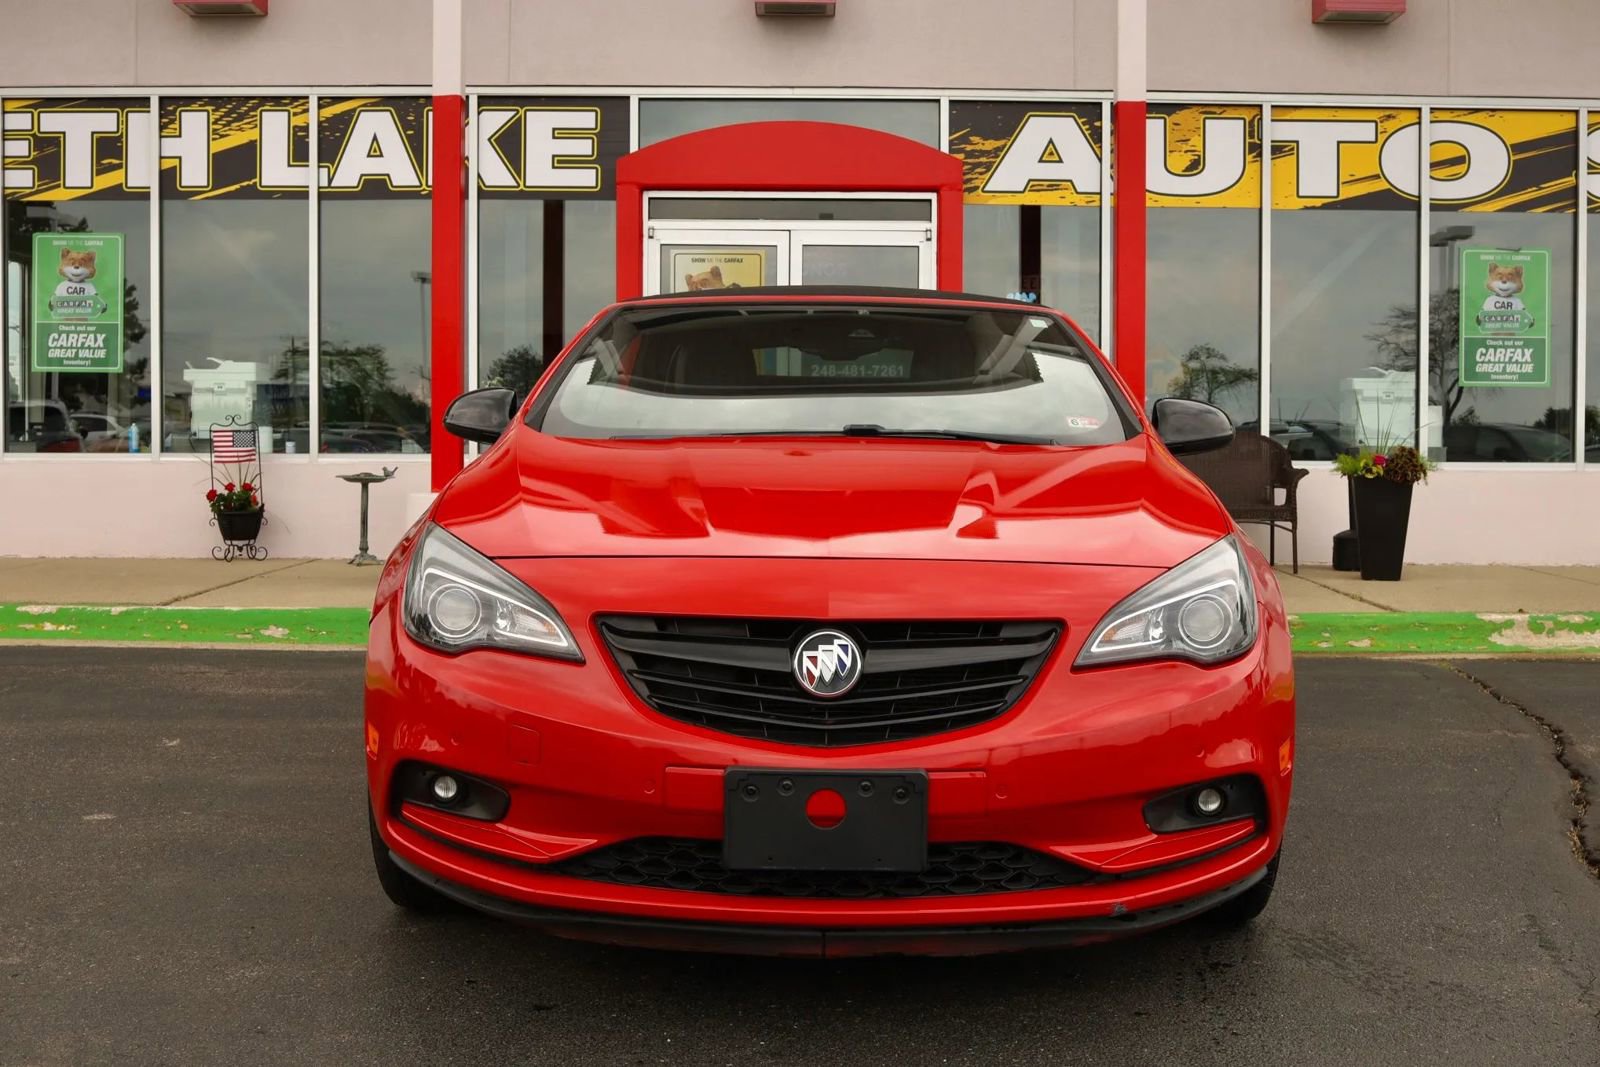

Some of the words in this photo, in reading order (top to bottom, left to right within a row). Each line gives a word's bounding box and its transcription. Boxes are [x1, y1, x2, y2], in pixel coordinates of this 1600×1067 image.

[260, 109, 598, 189] LAKE
[981, 115, 1510, 202] AUTO
[66, 286, 86, 295] CAR
[1494, 301, 1513, 310] CAR
[48, 333, 106, 347] CARFAX
[48, 349, 77, 358] GREAT
[78, 349, 107, 358] VALUE
[1475, 347, 1534, 362] CARFAX
[811, 365, 904, 377] 248-481-7261
[1475, 363, 1505, 373] GREAT
[1506, 363, 1535, 373] VALUE
